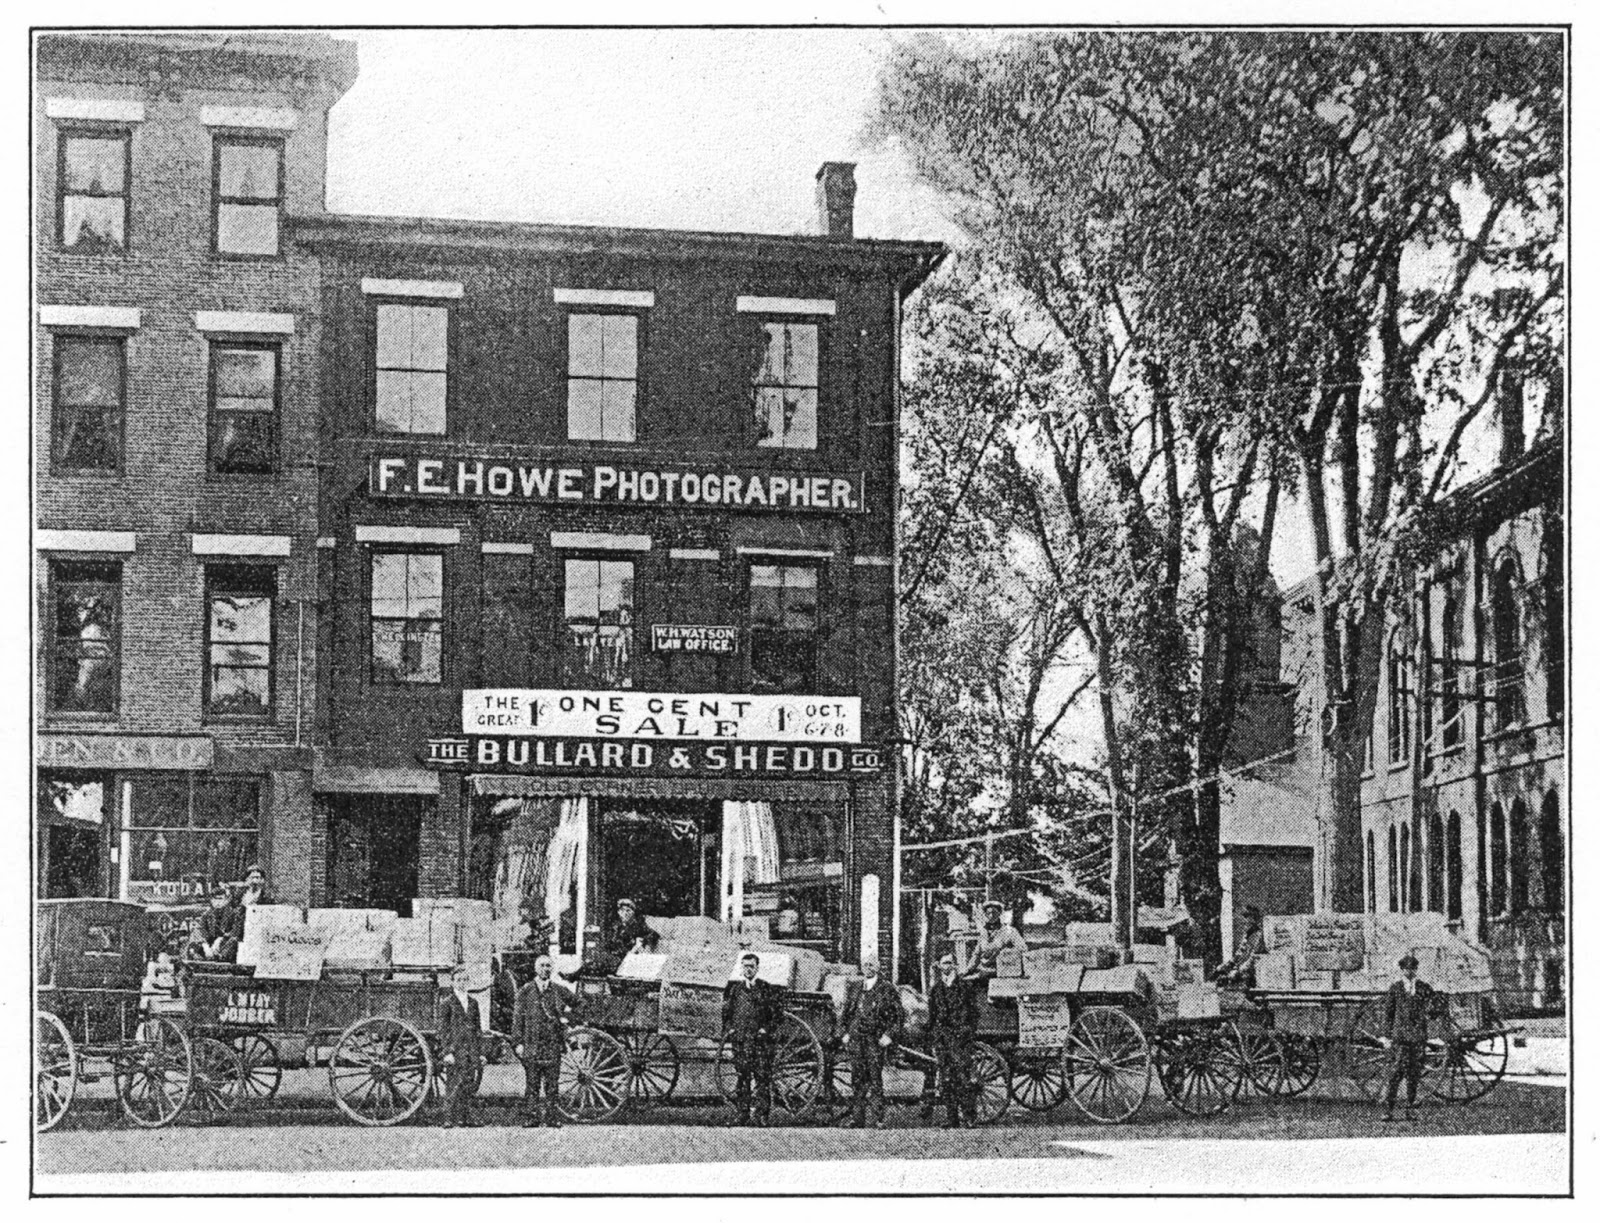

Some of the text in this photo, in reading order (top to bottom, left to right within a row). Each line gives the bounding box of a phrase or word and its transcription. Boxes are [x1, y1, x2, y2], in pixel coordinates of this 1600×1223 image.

[457, 461, 584, 498] HOWE
[594, 466, 858, 508] PHOTOGRAPHER.
[657, 638, 681, 650] LAW
[485, 696, 520, 710] THE
[559, 696, 751, 717] ONE CENT
[805, 704, 847, 719] OCT.
[478, 714, 519, 726] GREAT
[595, 715, 739, 737] SALE
[428, 744, 468, 758] THE
[478, 740, 653, 767] BULLARD
[669, 747, 691, 769] &
[706, 746, 844, 771] SHEDD
